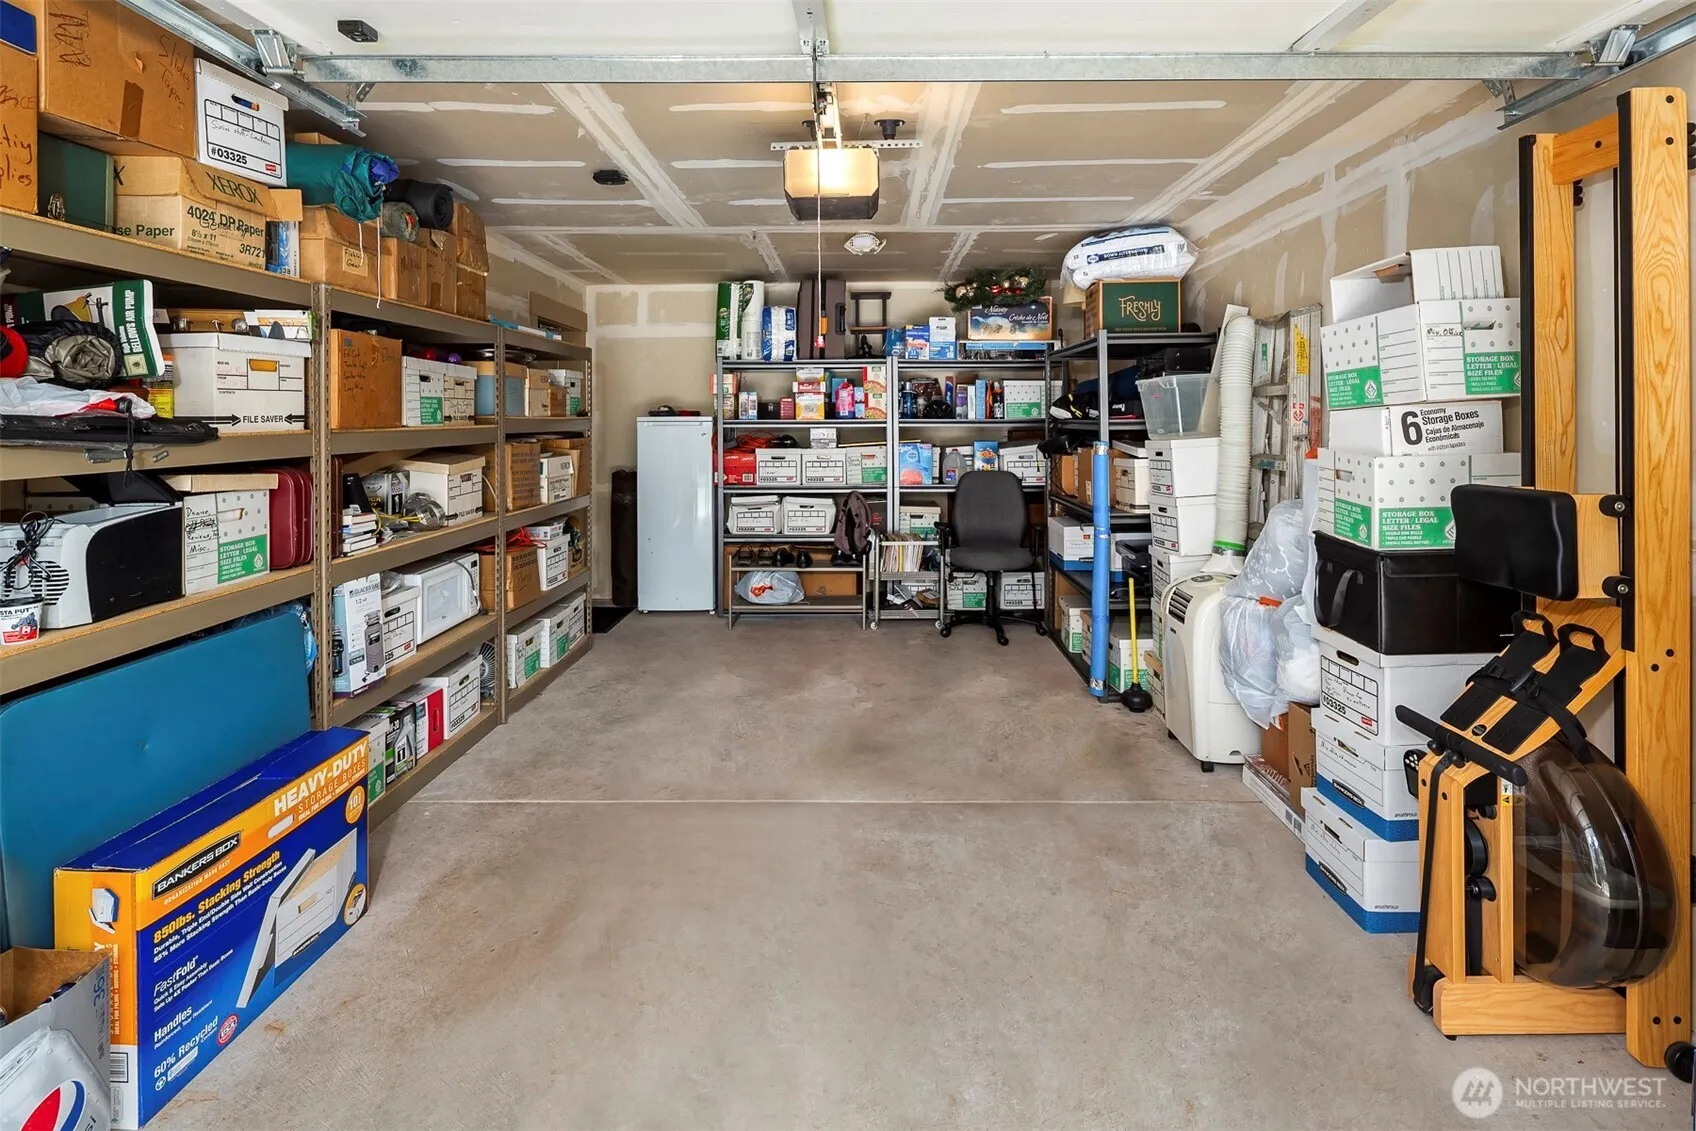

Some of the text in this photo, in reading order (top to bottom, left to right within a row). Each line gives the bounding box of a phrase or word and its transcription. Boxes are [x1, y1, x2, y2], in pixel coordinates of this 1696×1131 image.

[211, 146, 248, 165] #03325
[206, 171, 264, 207] XEROX
[187, 205, 216, 222] 4024
[136, 224, 175, 239] Paper
[124, 289, 143, 353] BELLOWS AIR PUMP
[1118, 295, 1162, 322] FRESHLY
[242, 415, 284, 424] FILE SAVER
[1400, 410, 1423, 446] 6
[1420, 408, 1447, 417] Economy
[1422, 410, 1480, 426] Storage Boxes
[1425, 428, 1442, 436] Cajas
[1451, 421, 1485, 432] Almacenaje
[1352, 505, 1361, 513] BOX
[220, 542, 245, 553] STORAGE
[220, 546, 258, 560] LETTER LEGAL
[220, 555, 247, 566] SIZE FILES
[274, 740, 368, 818] HEAVY-DUTY
[298, 758, 366, 813] STORAGE BOXES
[157, 836, 238, 893] BANKERS BOX
[153, 850, 280, 944] 850lbs. Stacking Strength
[163, 858, 232, 905] ORGANIZATION MADE EASY
[153, 935, 181, 955] Durable,
[181, 920, 198, 936] Triple
[230, 890, 242, 902] Side
[242, 882, 253, 894] Wall
[169, 936, 186, 953] More
[186, 919, 211, 941] Stacking
[211, 902, 235, 923] Strength
[235, 893, 248, 906] Than
[153, 989, 169, 1006] Quick
[165, 995, 174, 1005] Up
[197, 968, 209, 980] Than
[154, 1006, 193, 1043] Handles
[154, 1015, 219, 1078] 60% Recycled
